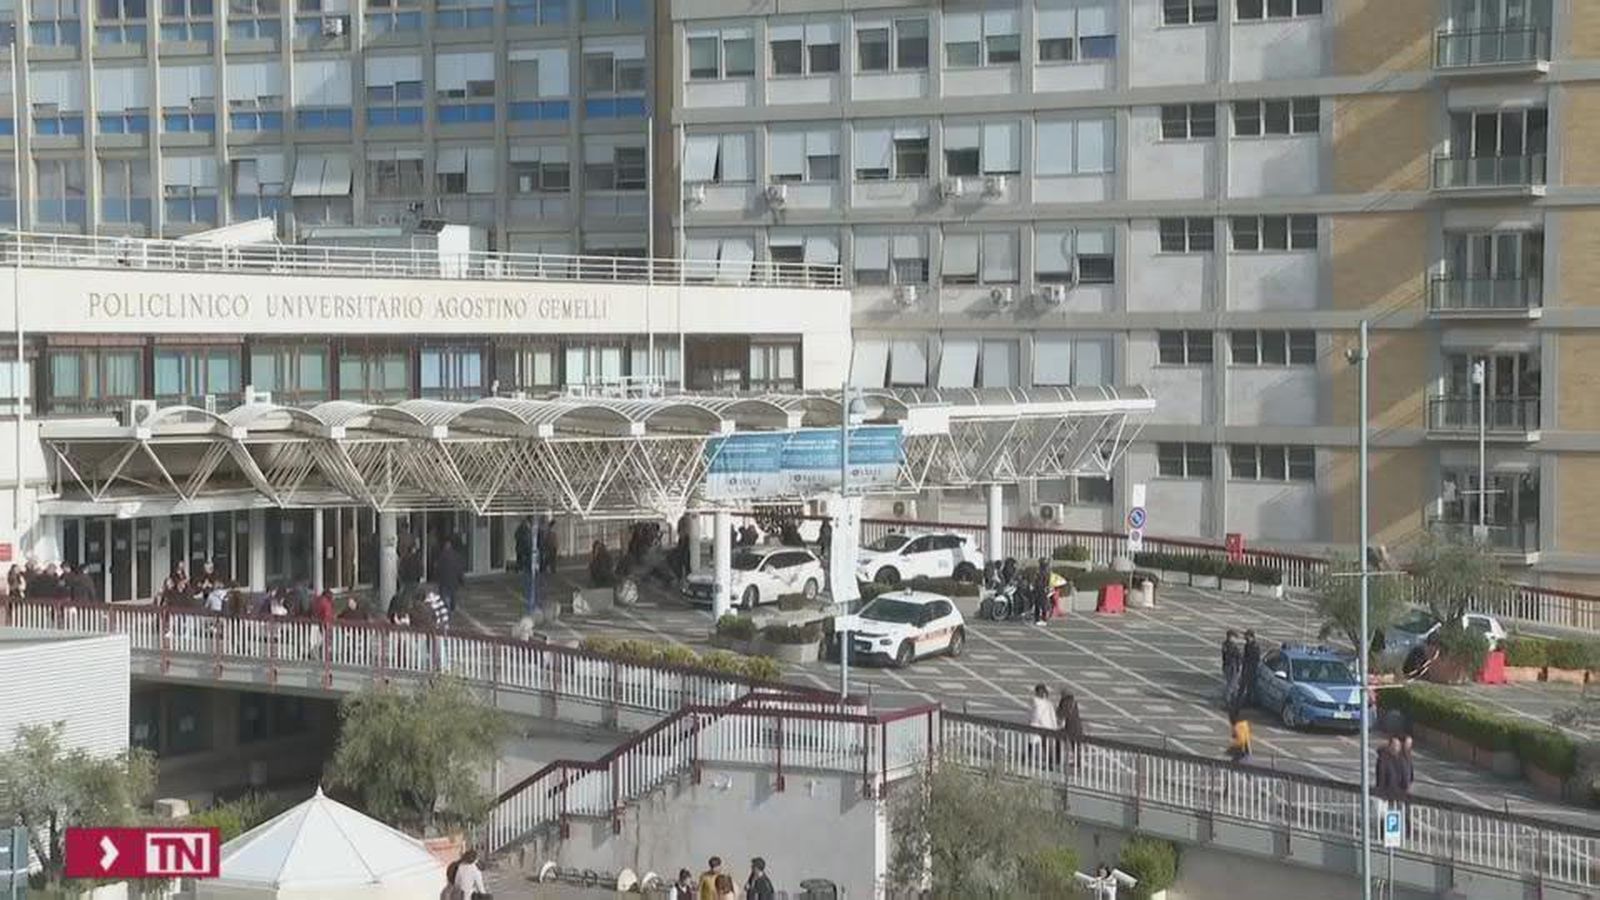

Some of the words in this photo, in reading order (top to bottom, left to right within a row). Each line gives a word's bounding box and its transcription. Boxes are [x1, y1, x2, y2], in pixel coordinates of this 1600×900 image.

[88, 292, 249, 319] POLICLINICO
[266, 294, 423, 319] UNIVERSITARIO
[434, 296, 528, 320] AGOSTINO
[537, 297, 608, 321] GEMELLI
[1388, 815, 1398, 831] P
